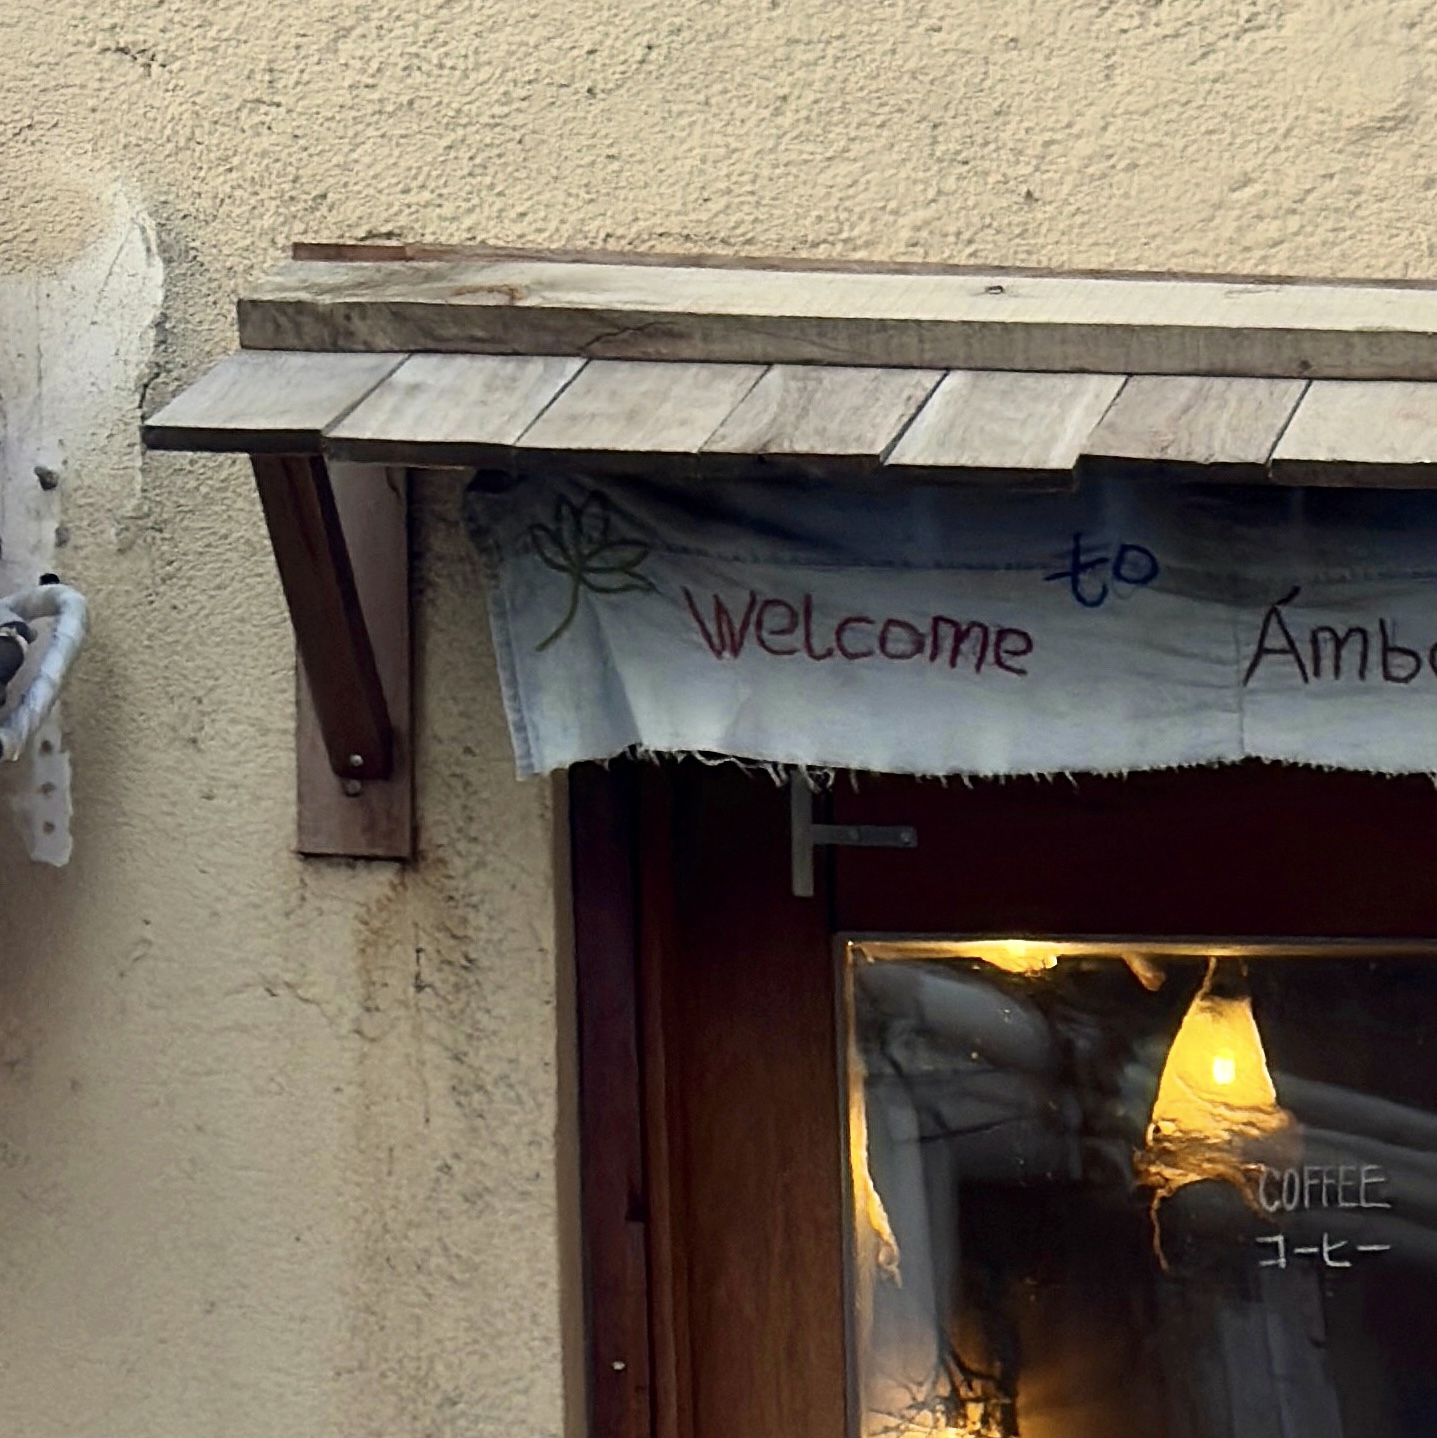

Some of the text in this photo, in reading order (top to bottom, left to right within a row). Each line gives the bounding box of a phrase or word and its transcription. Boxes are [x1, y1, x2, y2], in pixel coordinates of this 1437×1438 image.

[680, 584, 1036, 677] Welcome
[1043, 531, 1161, 608] to
[1258, 1163, 1393, 1212] COFFEE
[1254, 1231, 1392, 1270] コーヒー
